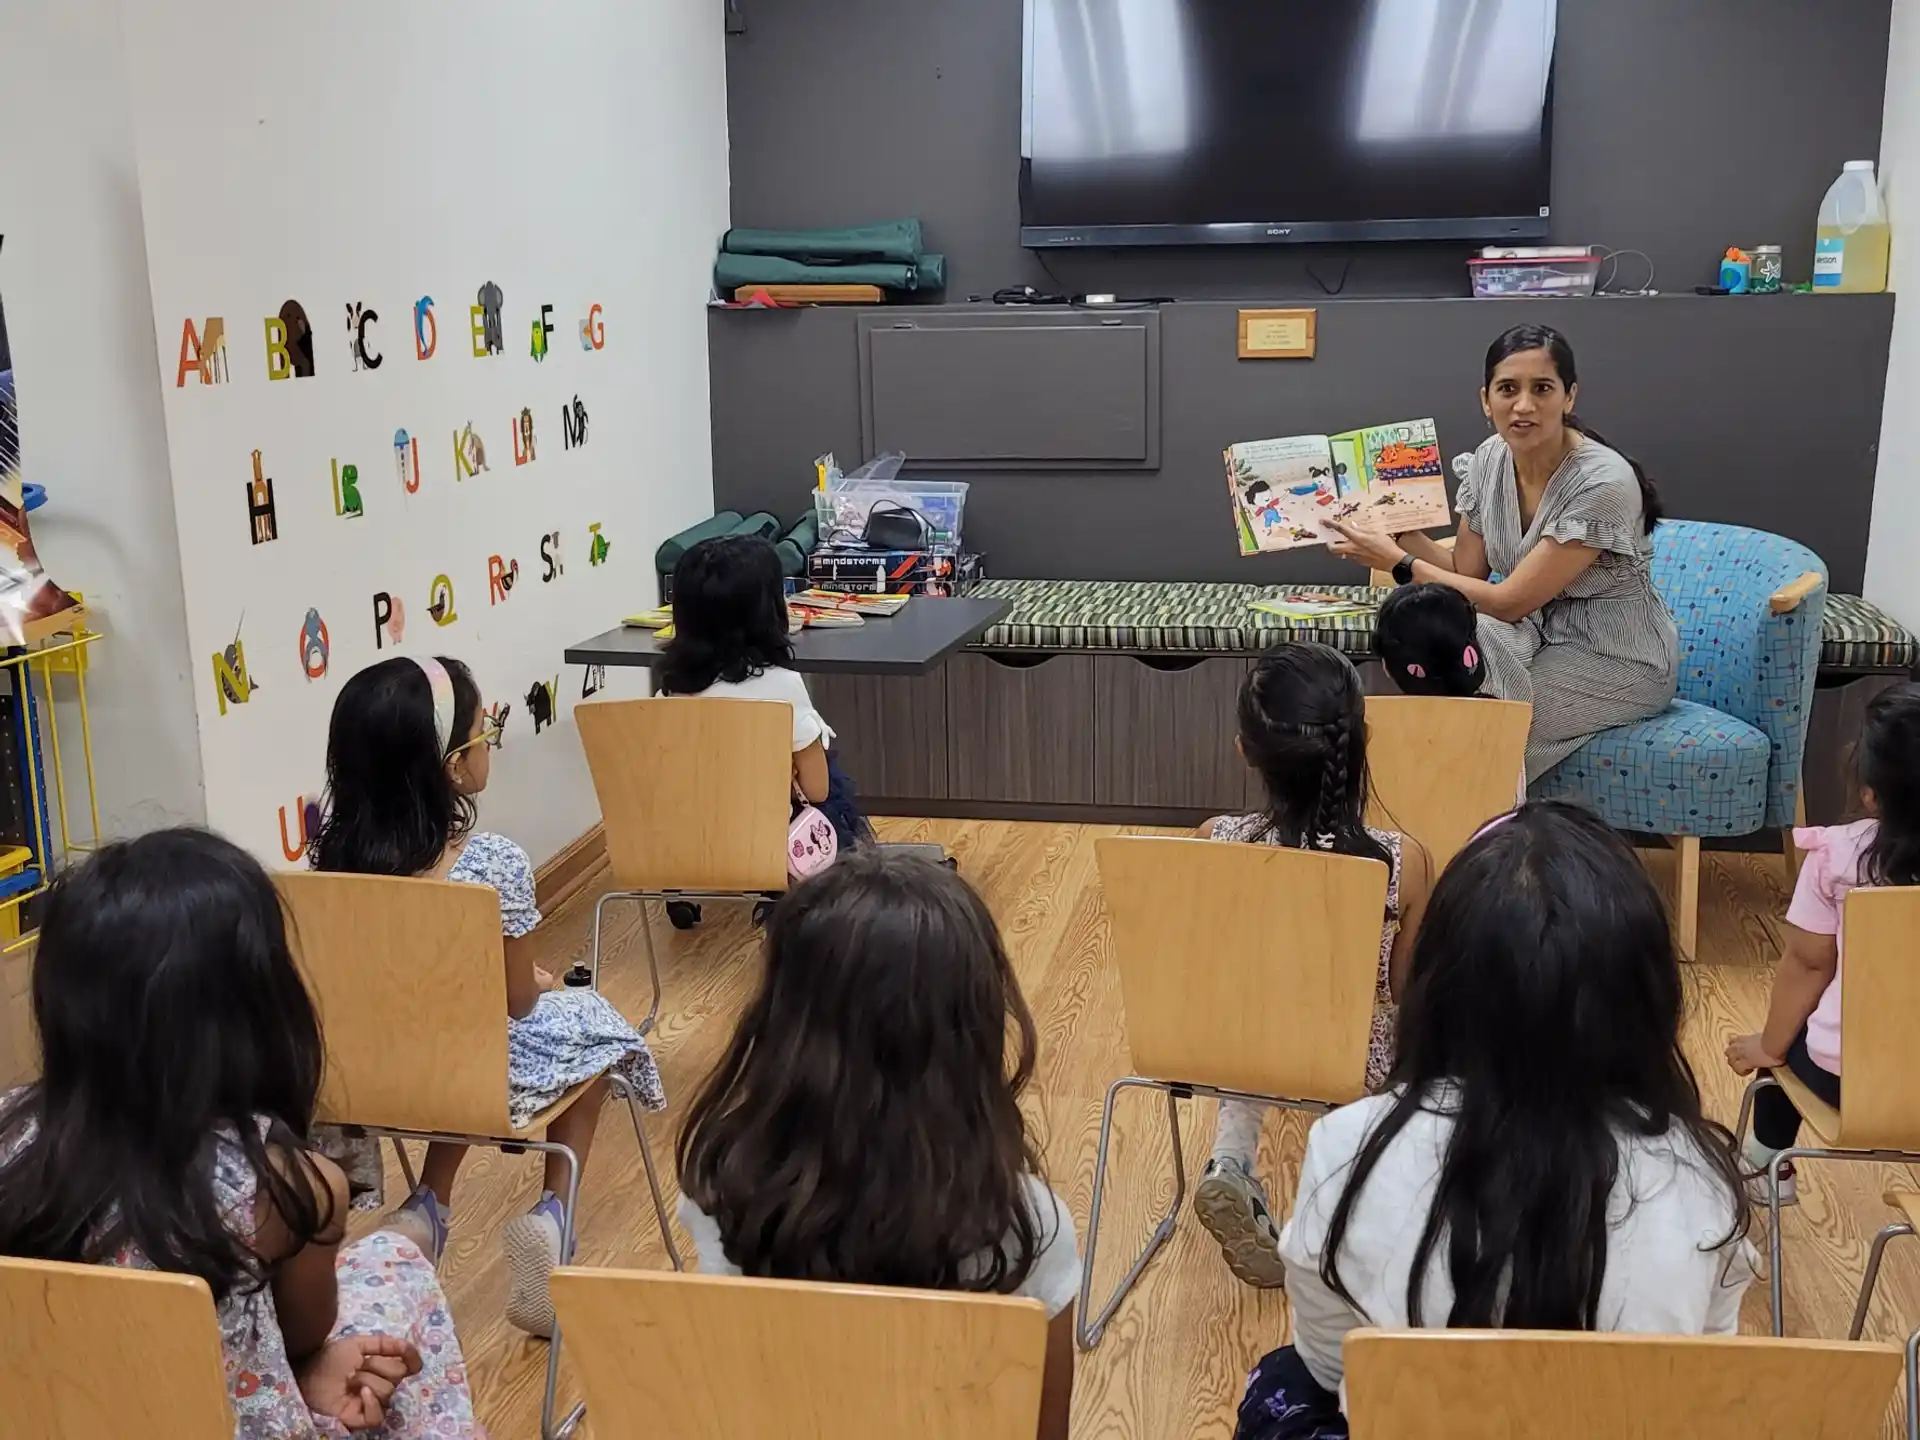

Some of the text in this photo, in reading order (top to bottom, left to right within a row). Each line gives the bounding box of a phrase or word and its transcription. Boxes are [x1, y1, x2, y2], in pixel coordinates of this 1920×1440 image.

[177, 317, 213, 388] A
[264, 316, 291, 381] B
[358, 309, 383, 369] C
[414, 303, 437, 361] D
[588, 303, 605, 350] G
[247, 477, 278, 545] H
[453, 423, 476, 482] K
[212, 639, 249, 716] N
[373, 591, 392, 650] P
[430, 574, 458, 627] Q
[488, 554, 508, 606] R
[540, 533, 553, 583] S
[278, 795, 306, 862] U
